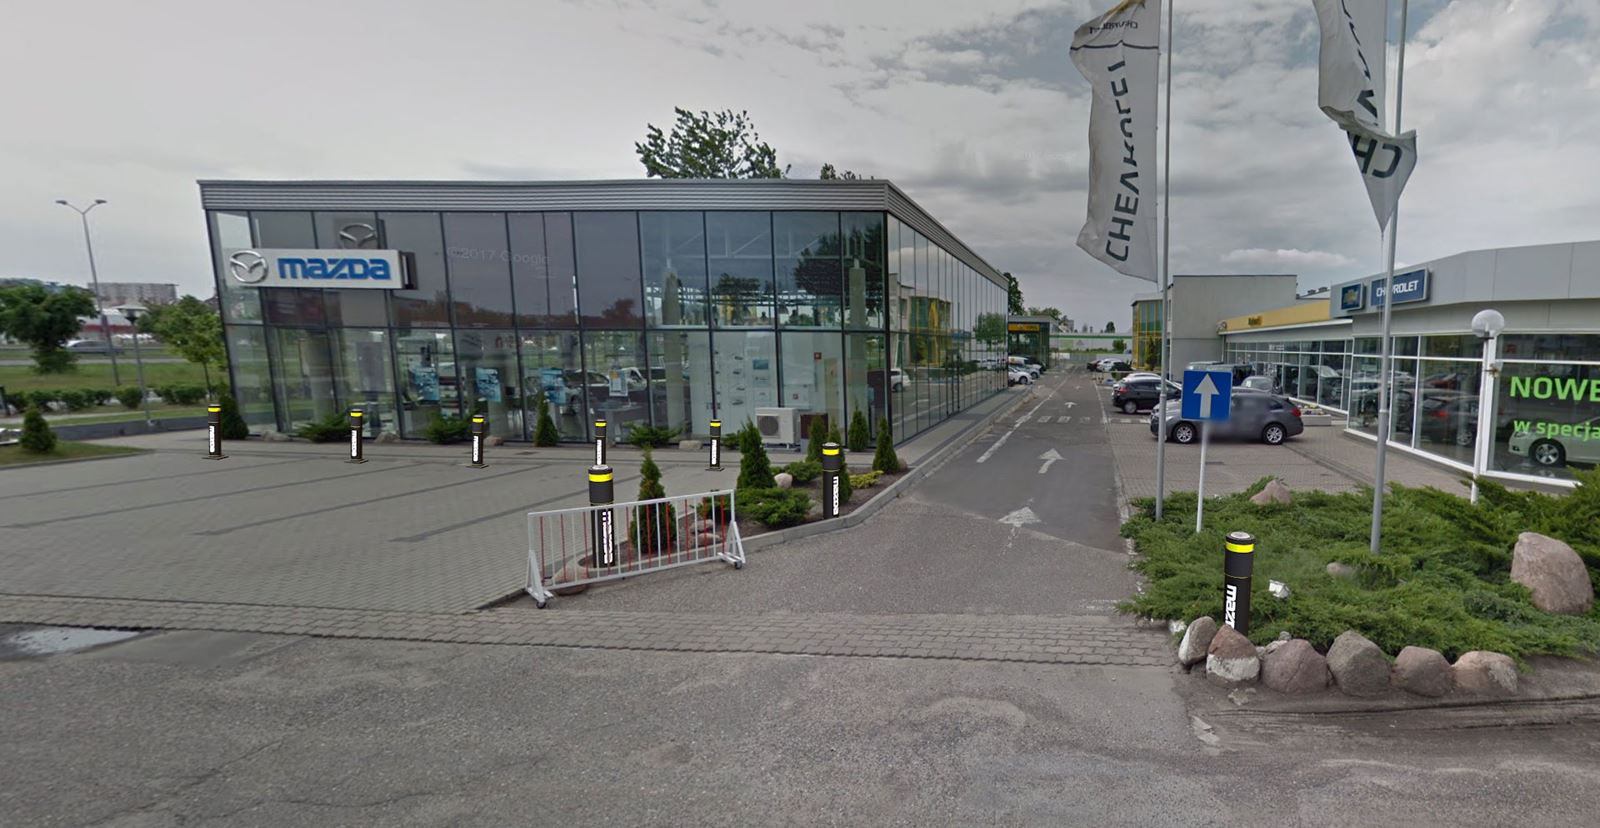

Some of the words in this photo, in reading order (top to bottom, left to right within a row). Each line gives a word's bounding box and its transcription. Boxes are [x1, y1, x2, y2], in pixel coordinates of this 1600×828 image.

[277, 257, 392, 280] mazda
[1376, 280, 1419, 297] CHROLET
[1513, 420, 1531, 433] w
